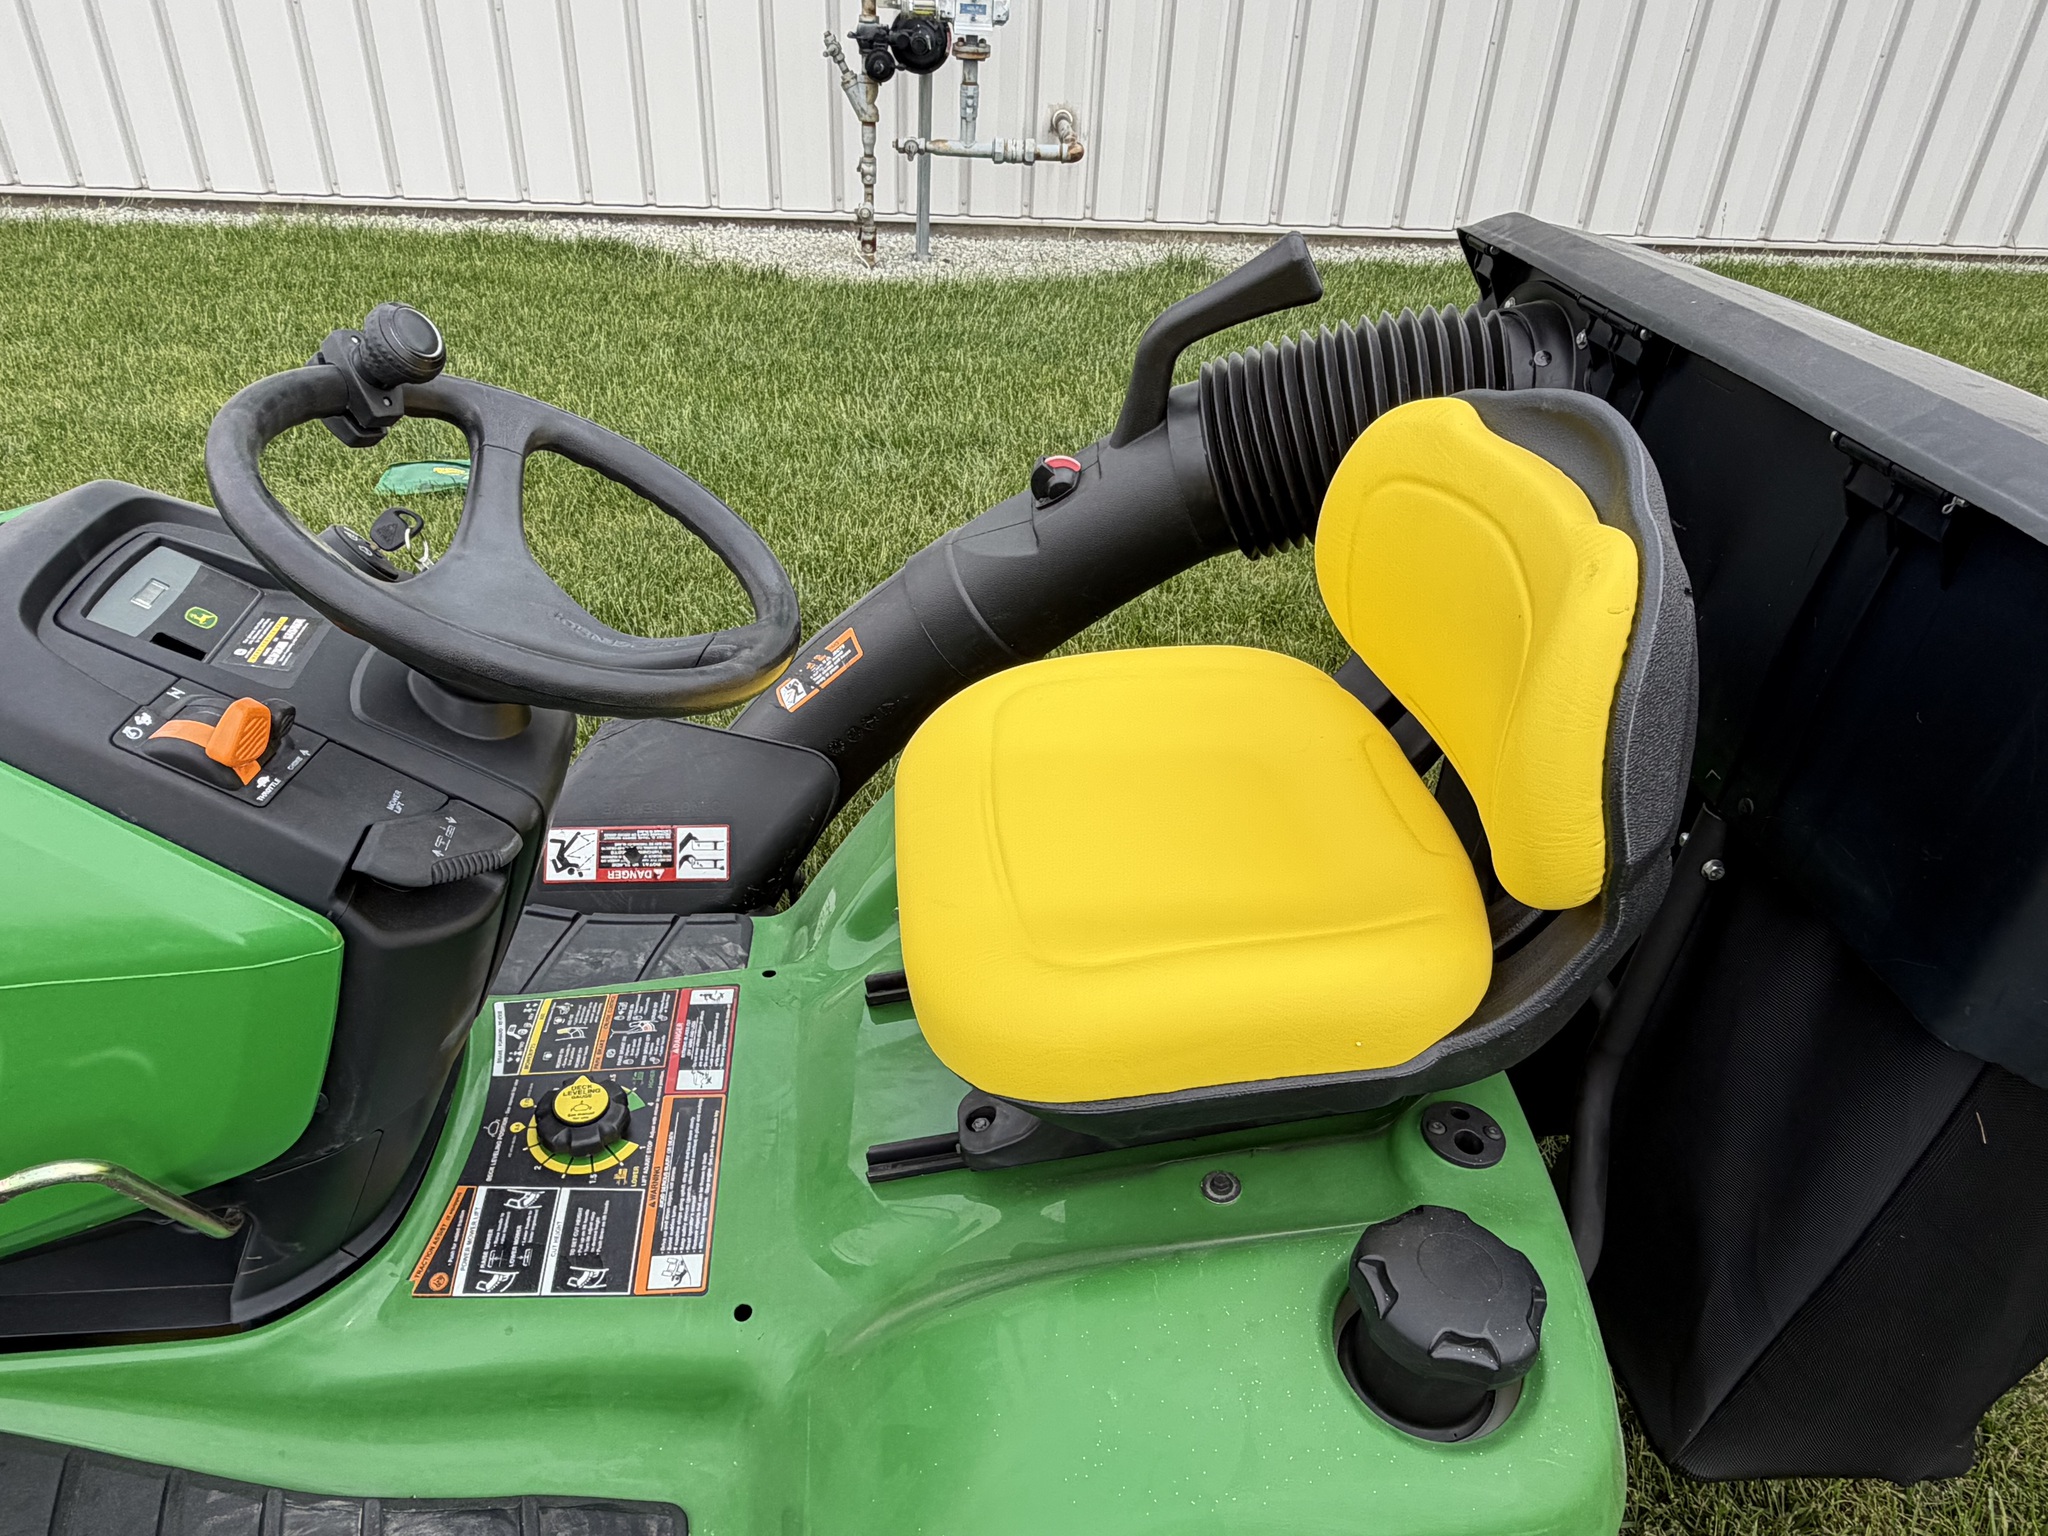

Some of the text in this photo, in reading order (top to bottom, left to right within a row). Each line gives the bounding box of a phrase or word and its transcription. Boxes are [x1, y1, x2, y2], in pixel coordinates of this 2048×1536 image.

[256, 777, 281, 802] THROTTLE
[385, 789, 402, 811] MOWER
[393, 800, 405, 814] LIFT
[608, 870, 652, 879] DANGER
[673, 1022, 683, 1048] DANGER
[563, 1088, 601, 1096] LEVELING
[629, 1165, 640, 1186] LOWER
[648, 1166, 661, 1201] WARNING
[459, 1206, 480, 1271] POWER MOWER LIFT
[553, 1221, 562, 1243] HEIGHT
[414, 1246, 436, 1279] TRACTION
[431, 1223, 447, 1245] ASSIST
